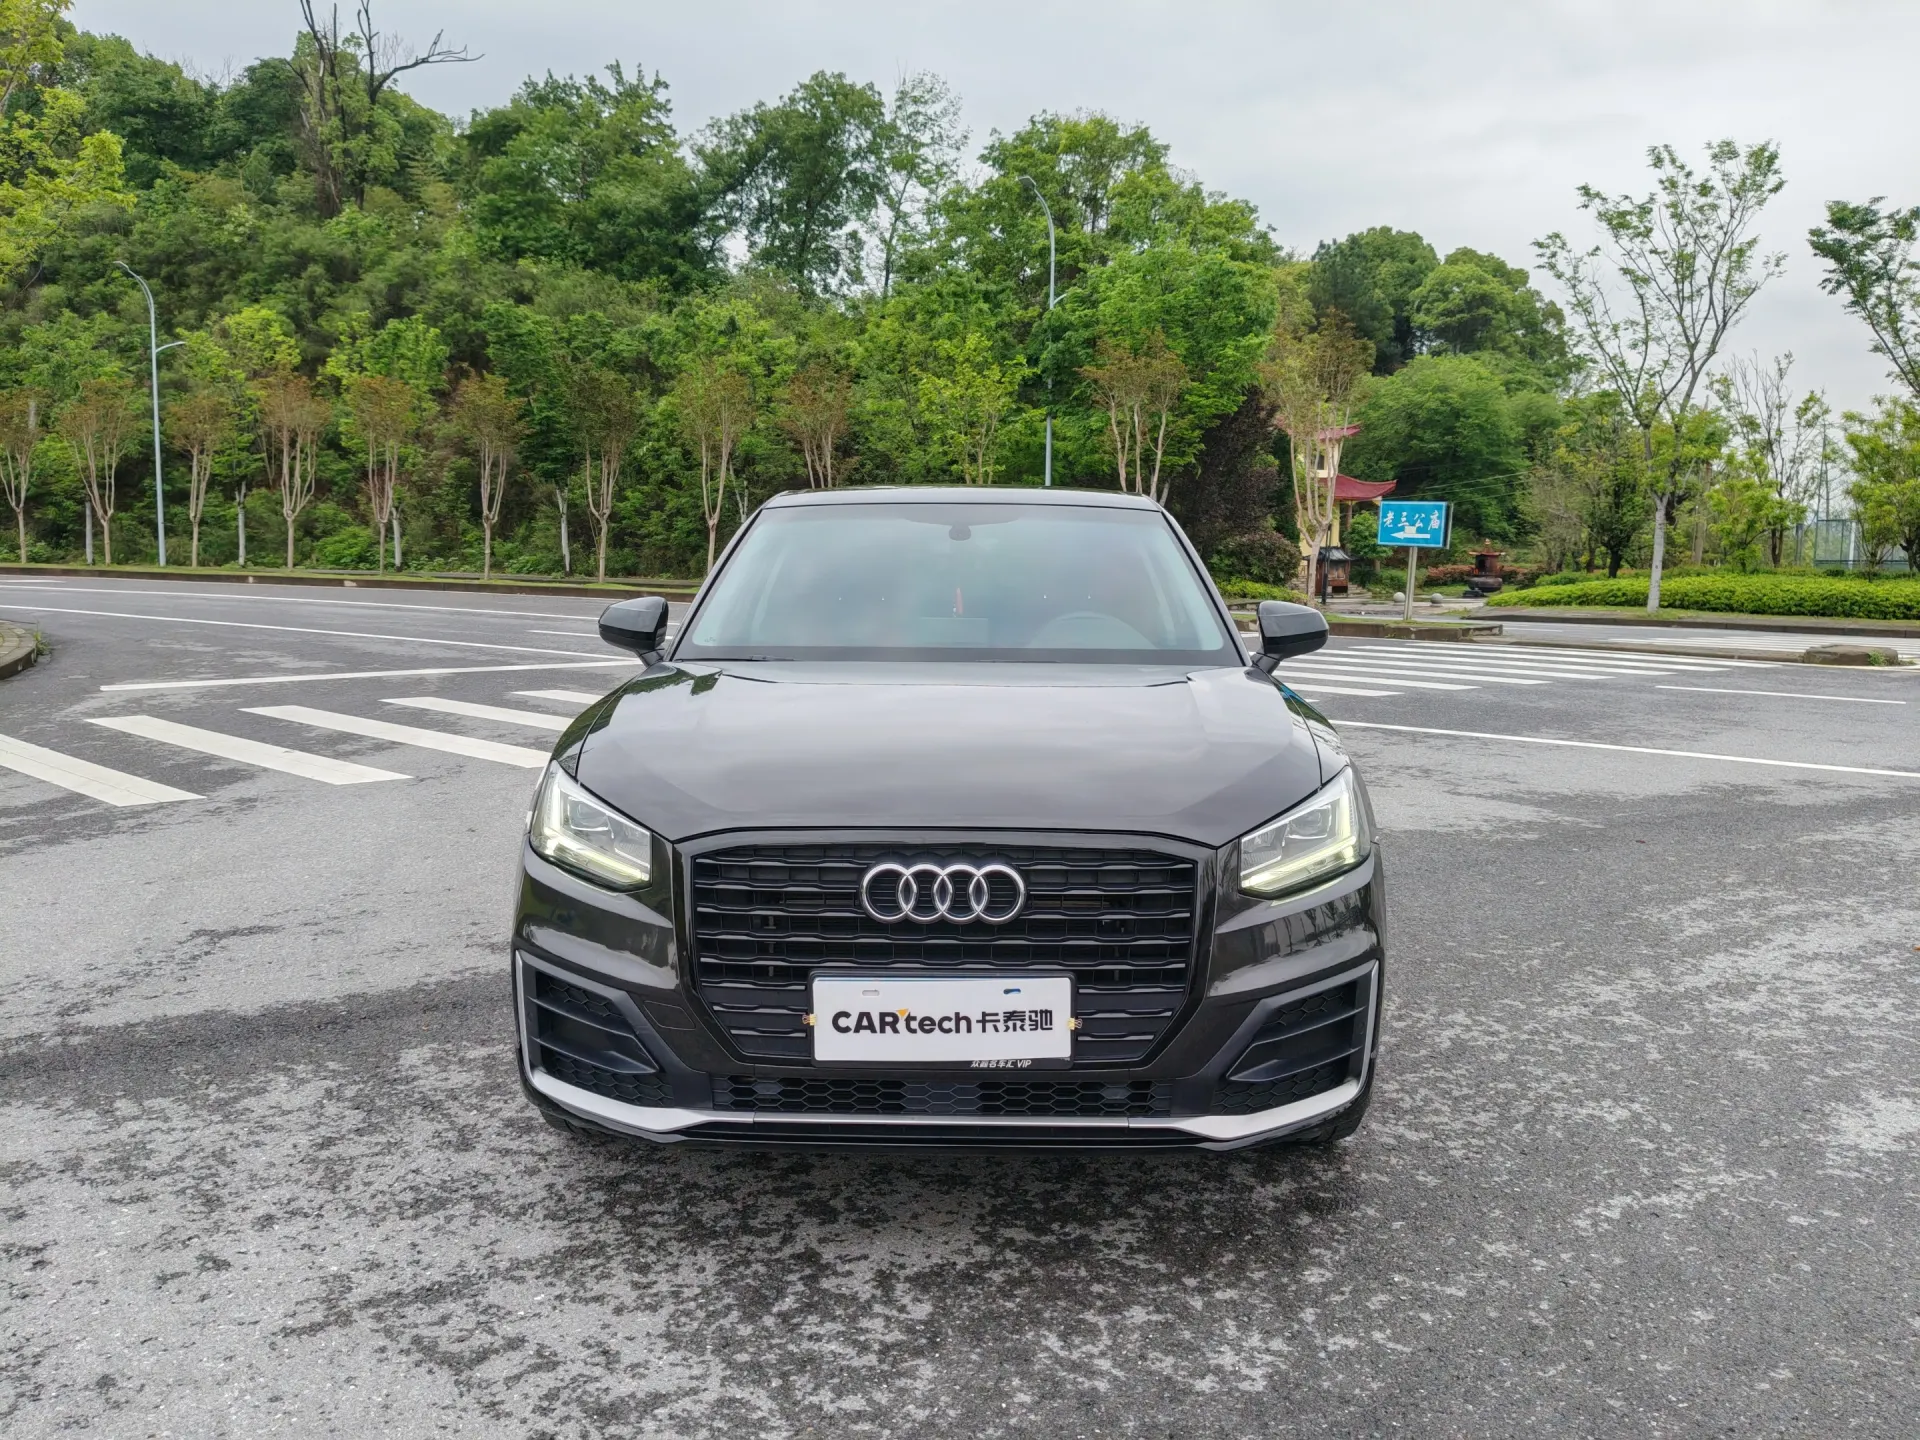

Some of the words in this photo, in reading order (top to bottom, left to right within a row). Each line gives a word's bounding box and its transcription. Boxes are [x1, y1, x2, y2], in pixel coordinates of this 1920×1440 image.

[831, 1010, 972, 1034] CARtech
[976, 1009, 1053, 1033] 卡泰驰
[1017, 1059, 1032, 1068] VIP
